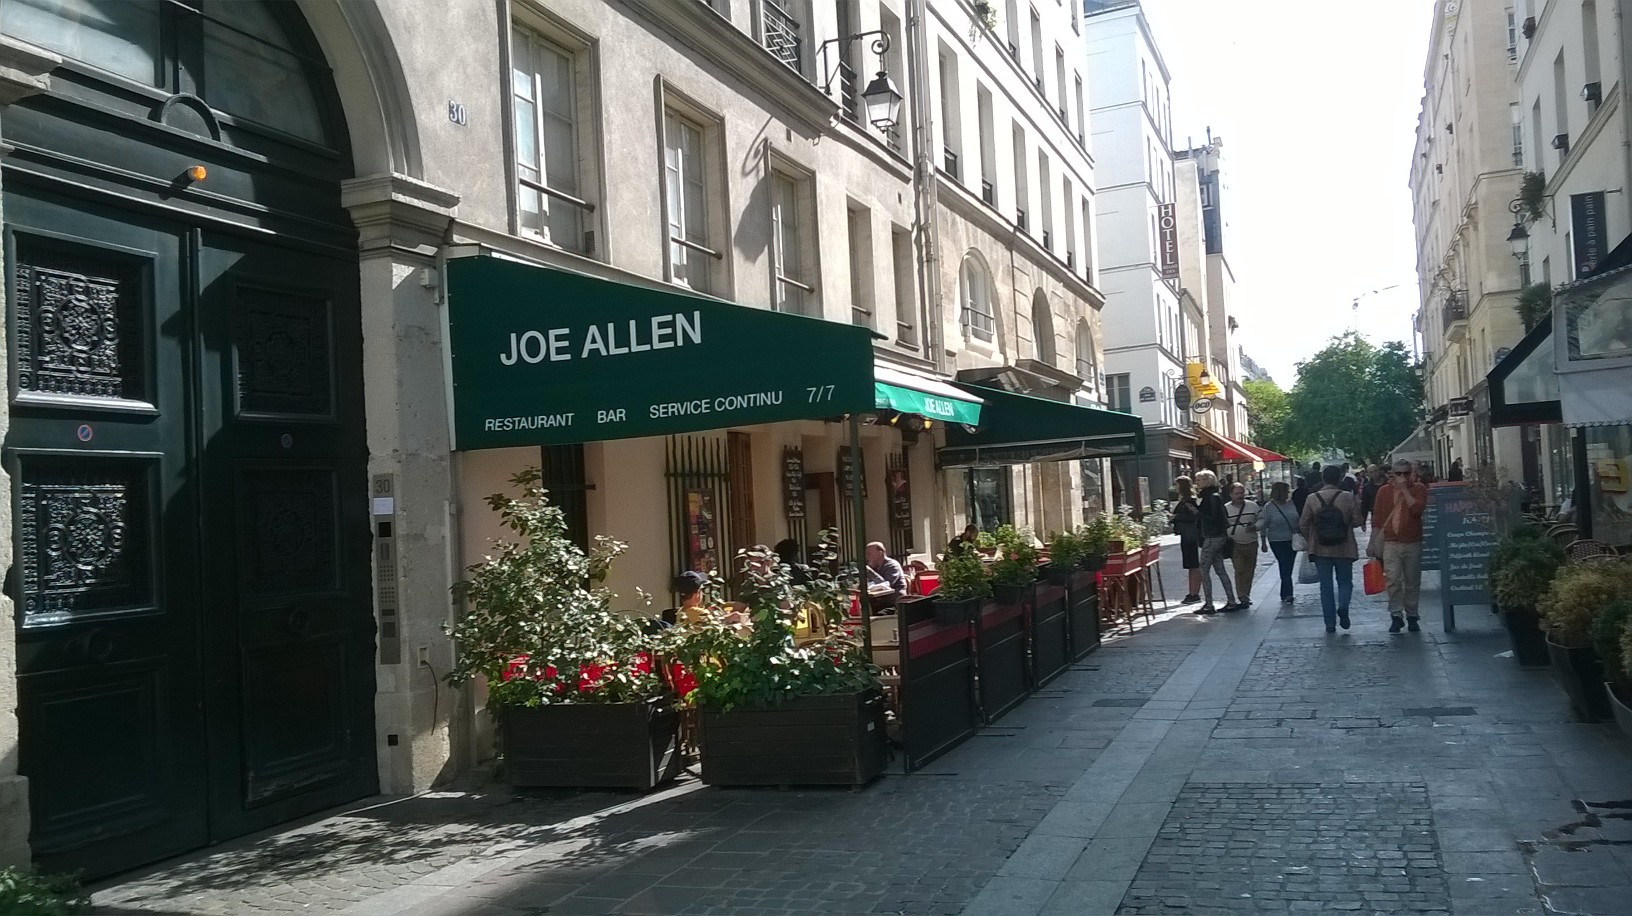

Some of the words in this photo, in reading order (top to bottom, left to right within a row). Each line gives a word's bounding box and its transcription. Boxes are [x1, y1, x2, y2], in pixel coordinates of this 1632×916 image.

[449, 100, 466, 125] 30
[1584, 195, 1596, 215] pain
[1161, 204, 1175, 265] HOTEL
[1585, 217, 1597, 238] pain
[500, 327, 572, 367] JOE
[581, 310, 702, 359] ALLEN
[484, 412, 575, 432] RESTAURANT
[597, 408, 626, 424] BAR
[649, 399, 712, 420] SERVICE
[714, 390, 783, 412] CONTINU
[806, 384, 836, 403] 7/7
[376, 479, 390, 493] 30
